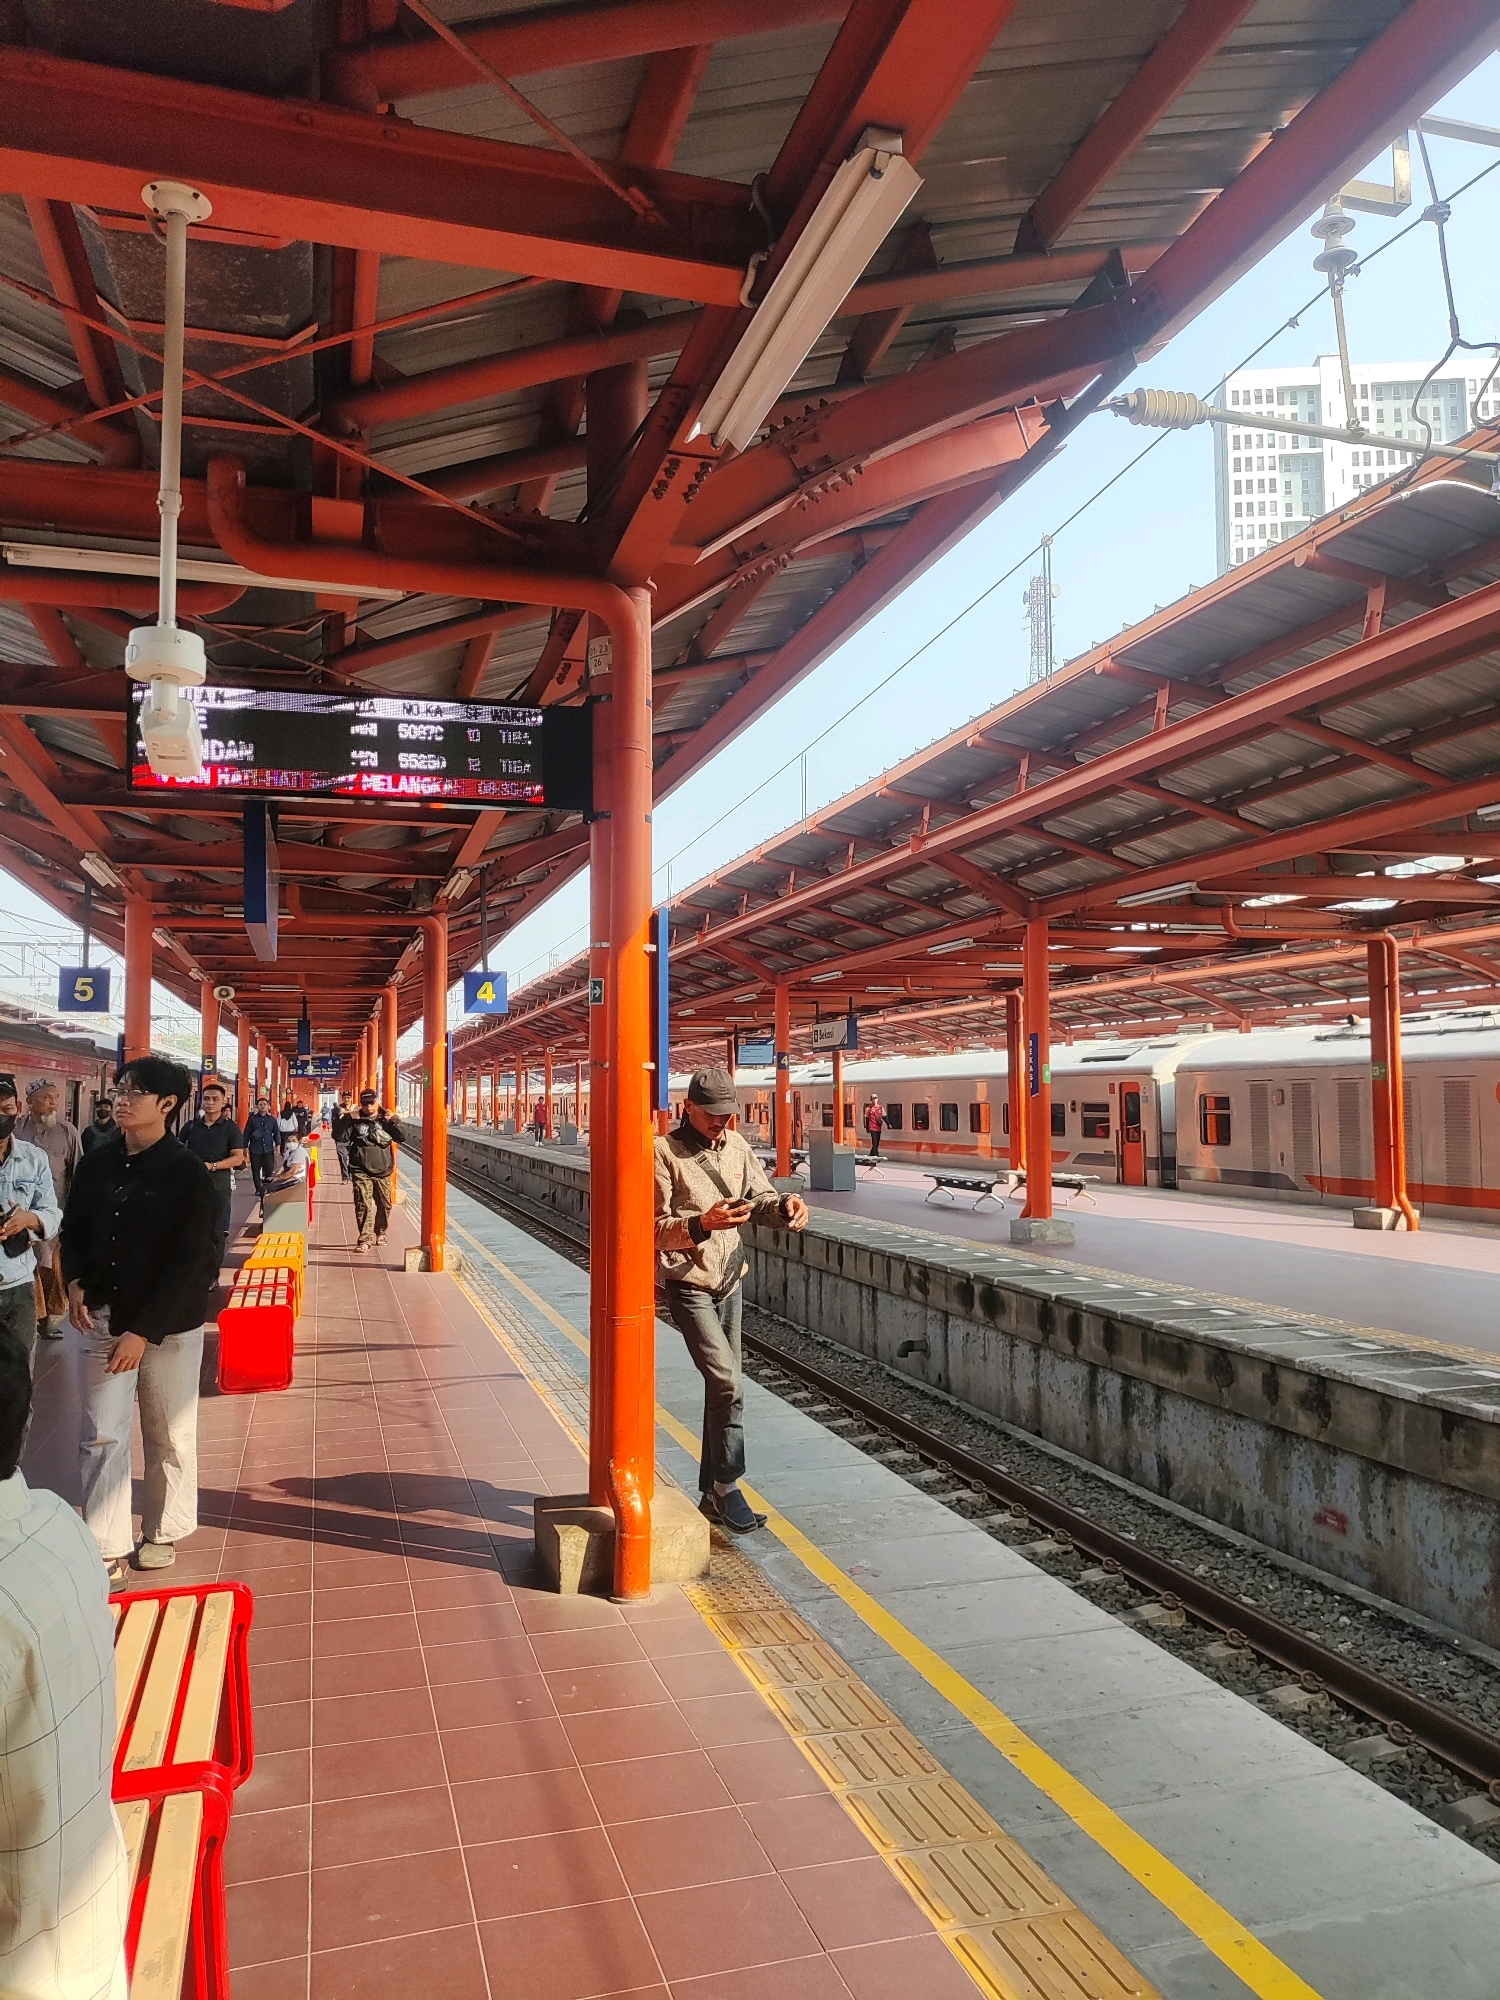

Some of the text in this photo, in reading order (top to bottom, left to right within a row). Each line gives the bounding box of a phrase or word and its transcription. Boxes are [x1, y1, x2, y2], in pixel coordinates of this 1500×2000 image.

[594, 659, 602, 667] 26
[73, 977, 94, 1002] 5
[477, 981, 496, 1004] 4
[819, 1028, 835, 1040] Bekasi
[204, 1058, 214, 1071] 5
[781, 1056, 788, 1066] 4
